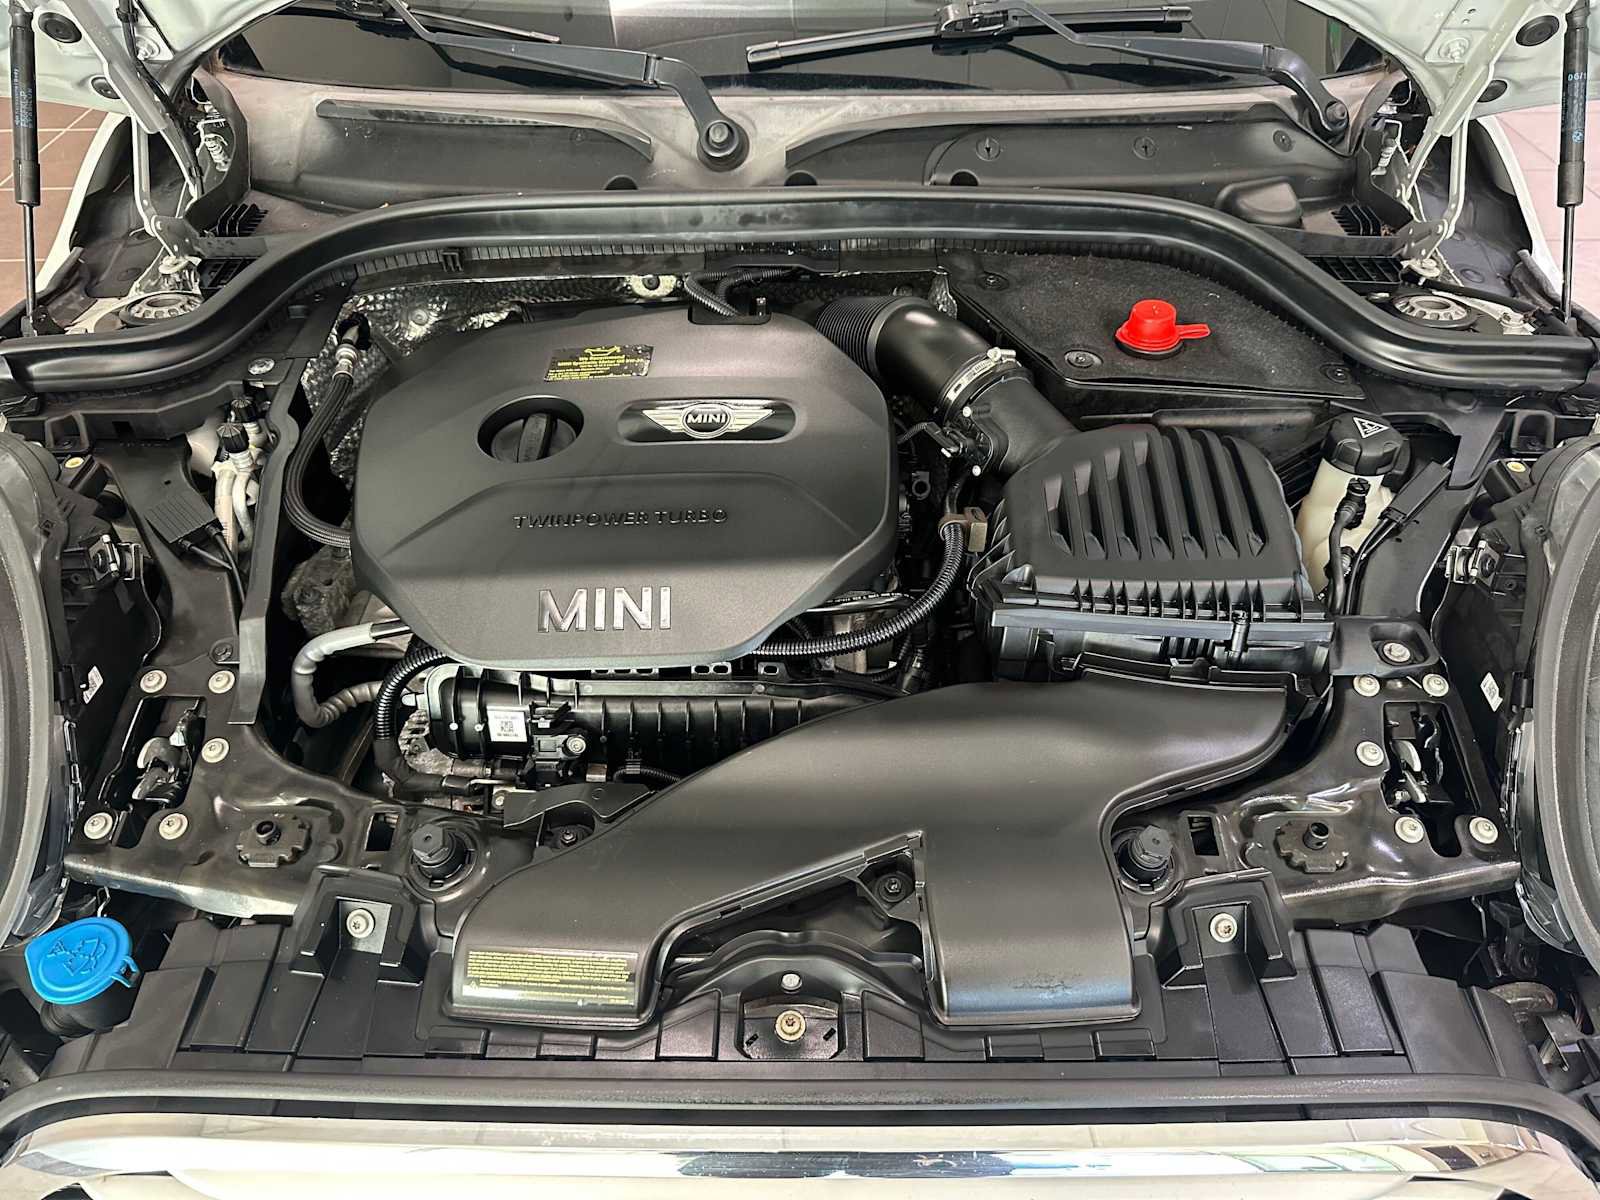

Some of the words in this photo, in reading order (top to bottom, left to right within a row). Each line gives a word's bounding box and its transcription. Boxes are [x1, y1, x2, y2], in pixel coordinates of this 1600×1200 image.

[686, 413, 727, 424] MINI
[513, 511, 649, 529] TWINPOWER
[655, 508, 729, 525] TURBO
[537, 585, 672, 633] MINI
